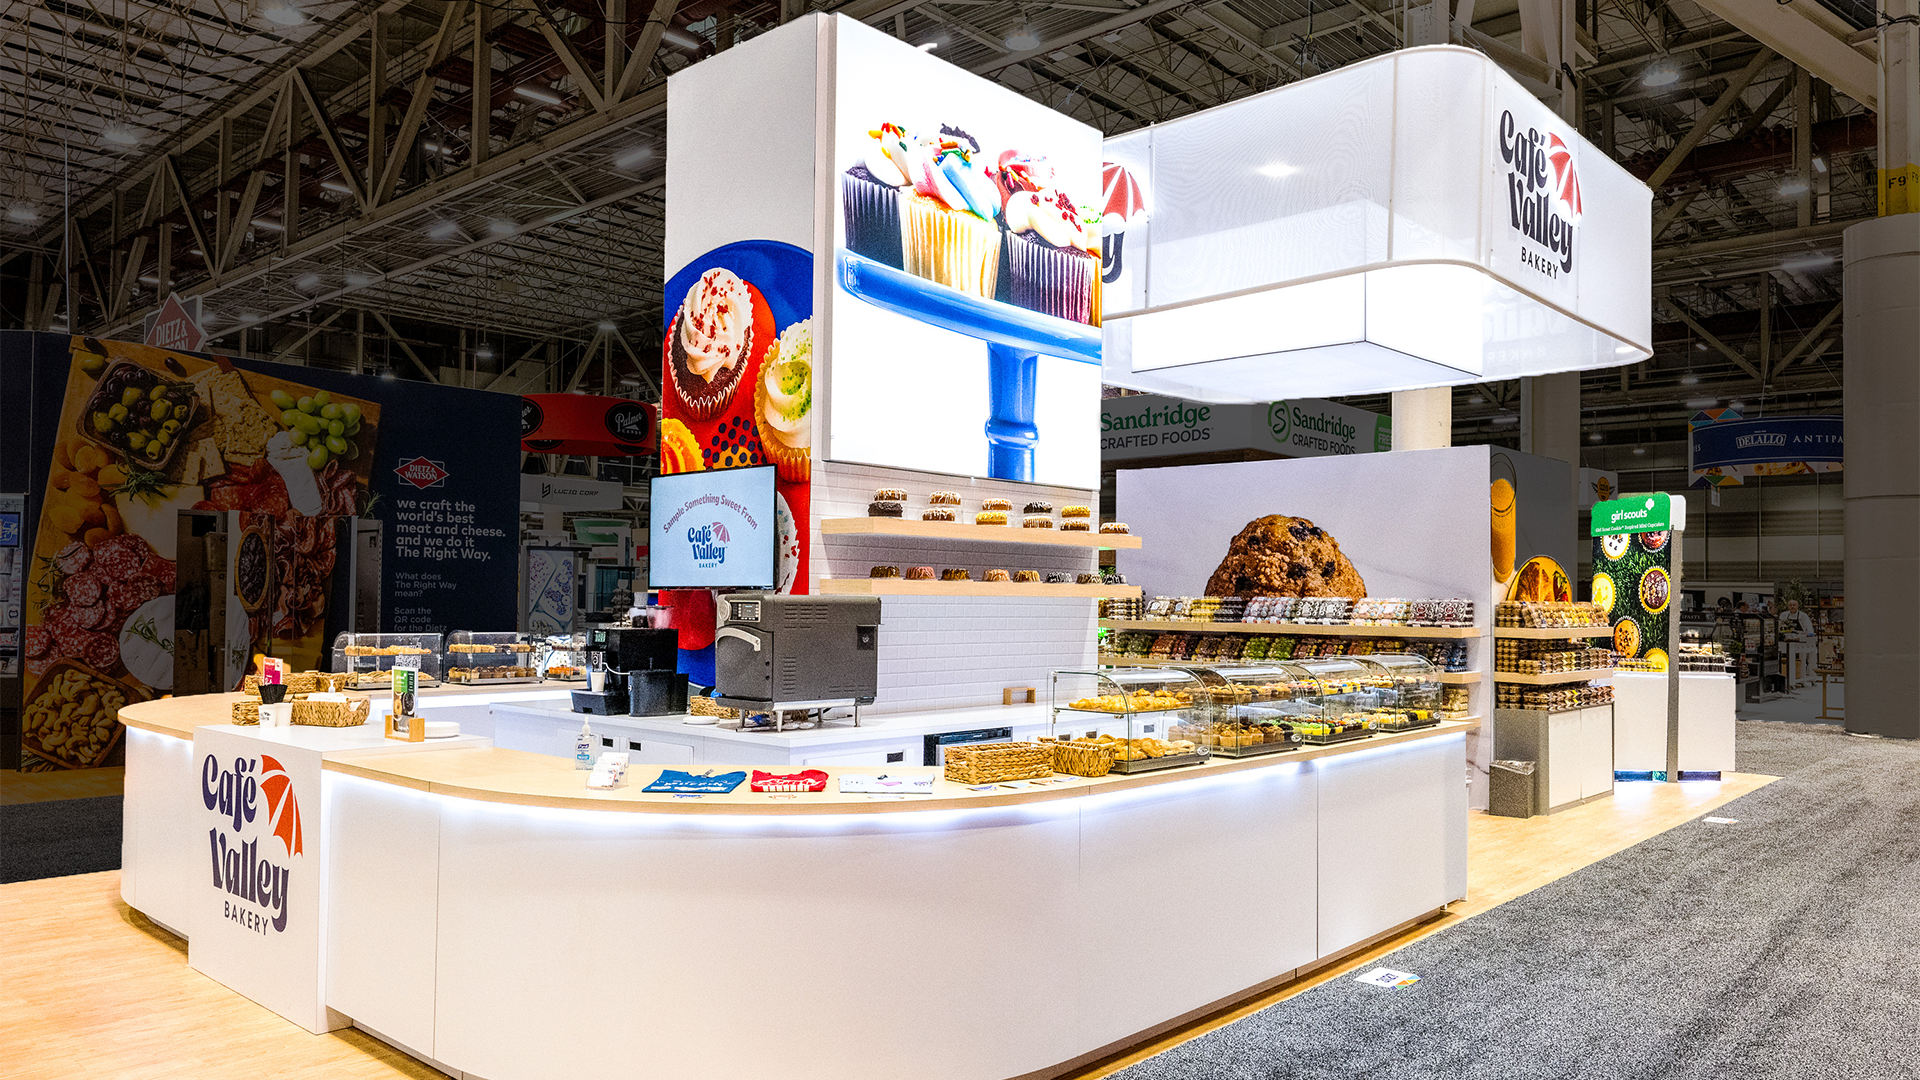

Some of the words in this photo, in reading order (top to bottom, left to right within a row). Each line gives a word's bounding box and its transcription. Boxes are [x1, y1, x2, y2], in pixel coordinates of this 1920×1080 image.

[1500, 110, 1548, 193] Café
[1889, 176, 1906, 189] F9
[1508, 172, 1574, 274] Valley
[1521, 246, 1559, 280] BAKERY
[614, 411, 644, 433] Palmer
[1100, 402, 1211, 432] Sandridge
[1292, 407, 1356, 443] Sandridge
[1100, 433, 1158, 450] CRAFTED
[1161, 427, 1211, 445] FOODS
[1292, 433, 1329, 451] CRAFTED
[404, 471, 437, 481] WATSON
[419, 499, 452, 511] craft
[454, 501, 476, 513] the
[663, 507, 685, 533] Sample
[684, 493, 720, 512] Something
[720, 495, 742, 513] Sweet
[740, 507, 758, 530] From
[446, 513, 475, 524] best
[1611, 509, 1623, 523] girl
[1624, 508, 1648, 520] scouts
[396, 523, 431, 534] meat
[434, 523, 459, 535] and
[461, 525, 506, 537] cheese.
[687, 524, 712, 546] Café
[396, 534, 421, 546] and
[424, 537, 443, 547] we
[446, 536, 462, 547] do
[465, 536, 475, 548] it
[395, 546, 420, 558] The
[423, 546, 458, 561] Right
[460, 548, 491, 562] Way.
[692, 542, 726, 564] Valley
[395, 572, 419, 580] What
[420, 572, 442, 581] does
[394, 588, 423, 598] mean?
[395, 580, 411, 589] The
[413, 581, 437, 591] Right
[438, 581, 457, 591] Way
[394, 606, 416, 615] Scan
[417, 607, 432, 615] the
[394, 615, 409, 624] QR
[410, 615, 432, 624] code
[393, 624, 407, 632] for
[409, 624, 423, 632] the
[425, 624, 448, 633] Dietz
[202, 754, 257, 833] Café
[209, 827, 290, 933] Valley
[224, 900, 269, 936] BAKERY
